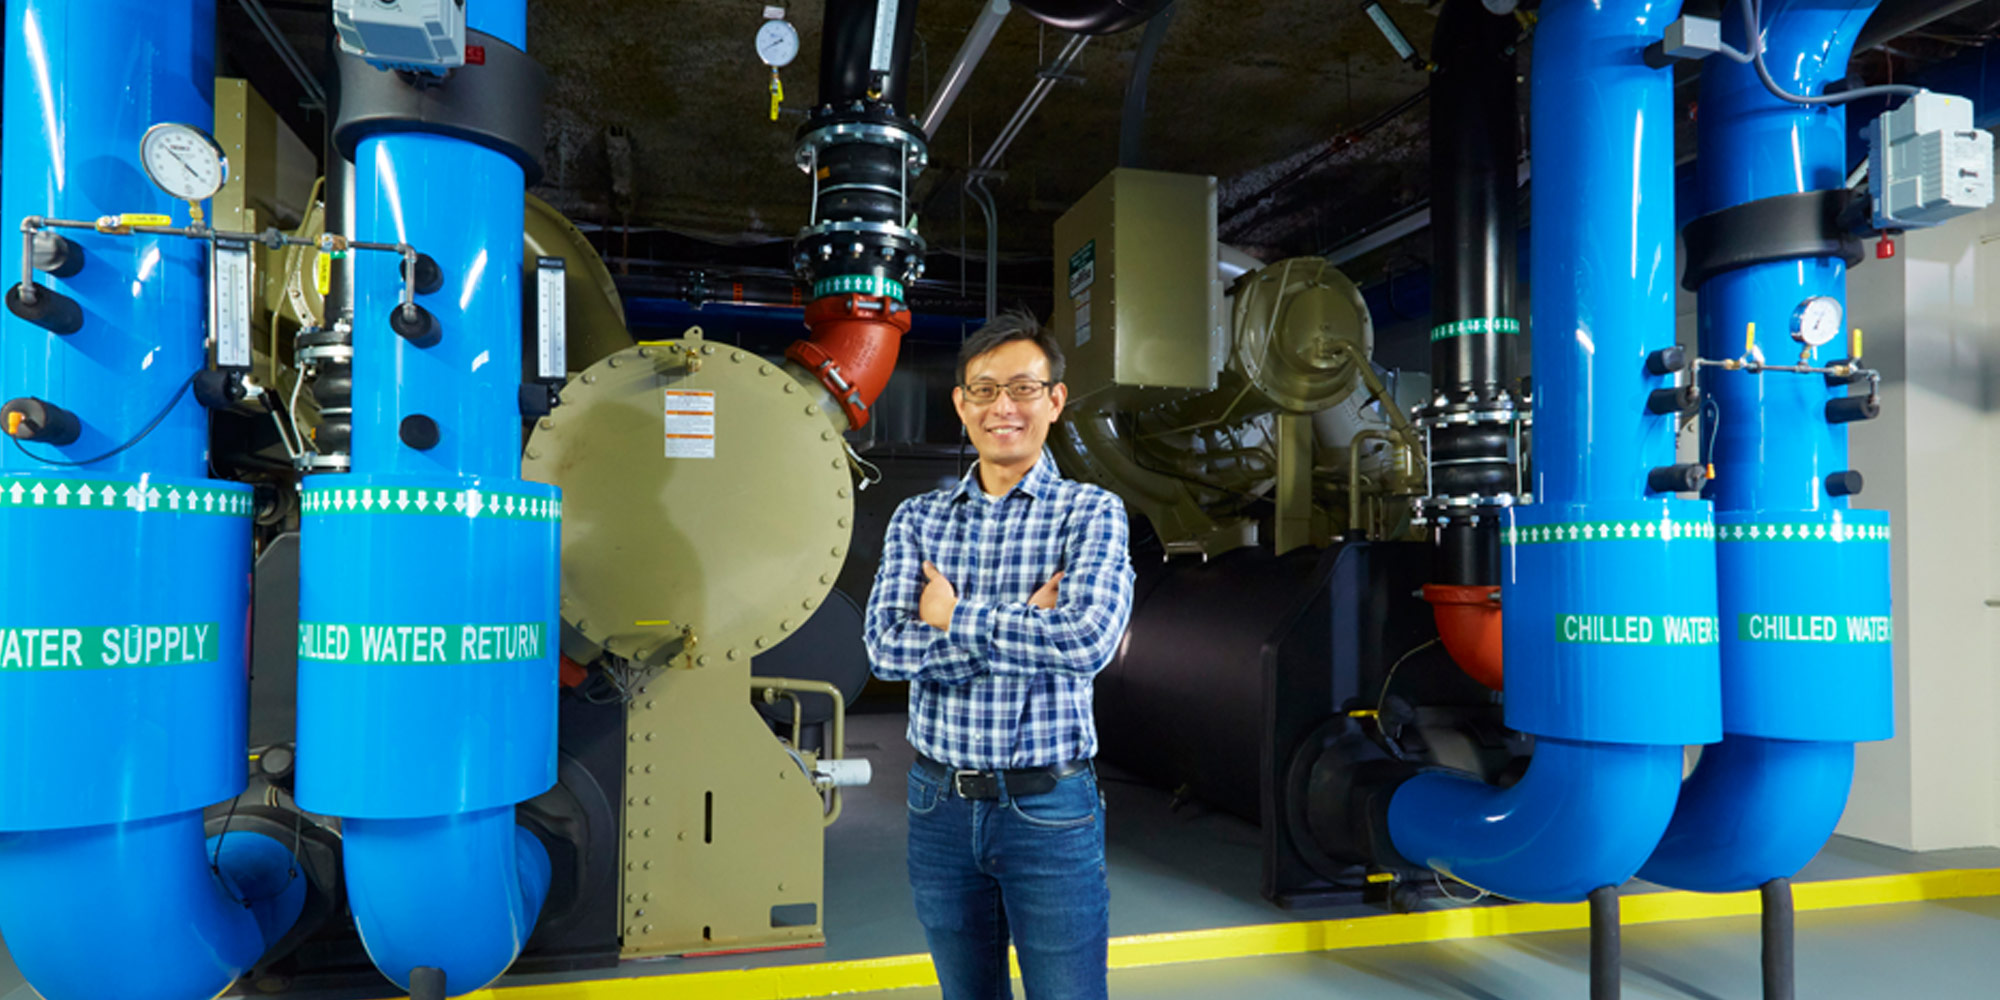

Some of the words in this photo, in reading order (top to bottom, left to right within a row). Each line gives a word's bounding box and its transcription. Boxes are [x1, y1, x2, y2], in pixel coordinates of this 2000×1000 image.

[360, 625, 447, 662] WATER
[461, 624, 540, 661] RETURN
[1563, 615, 1653, 643] CHILLED
[1663, 615, 1713, 644] WATER
[1749, 614, 1837, 642] CHILLED
[0, 628, 83, 668] ATER
[101, 624, 209, 666] SUPPLY
